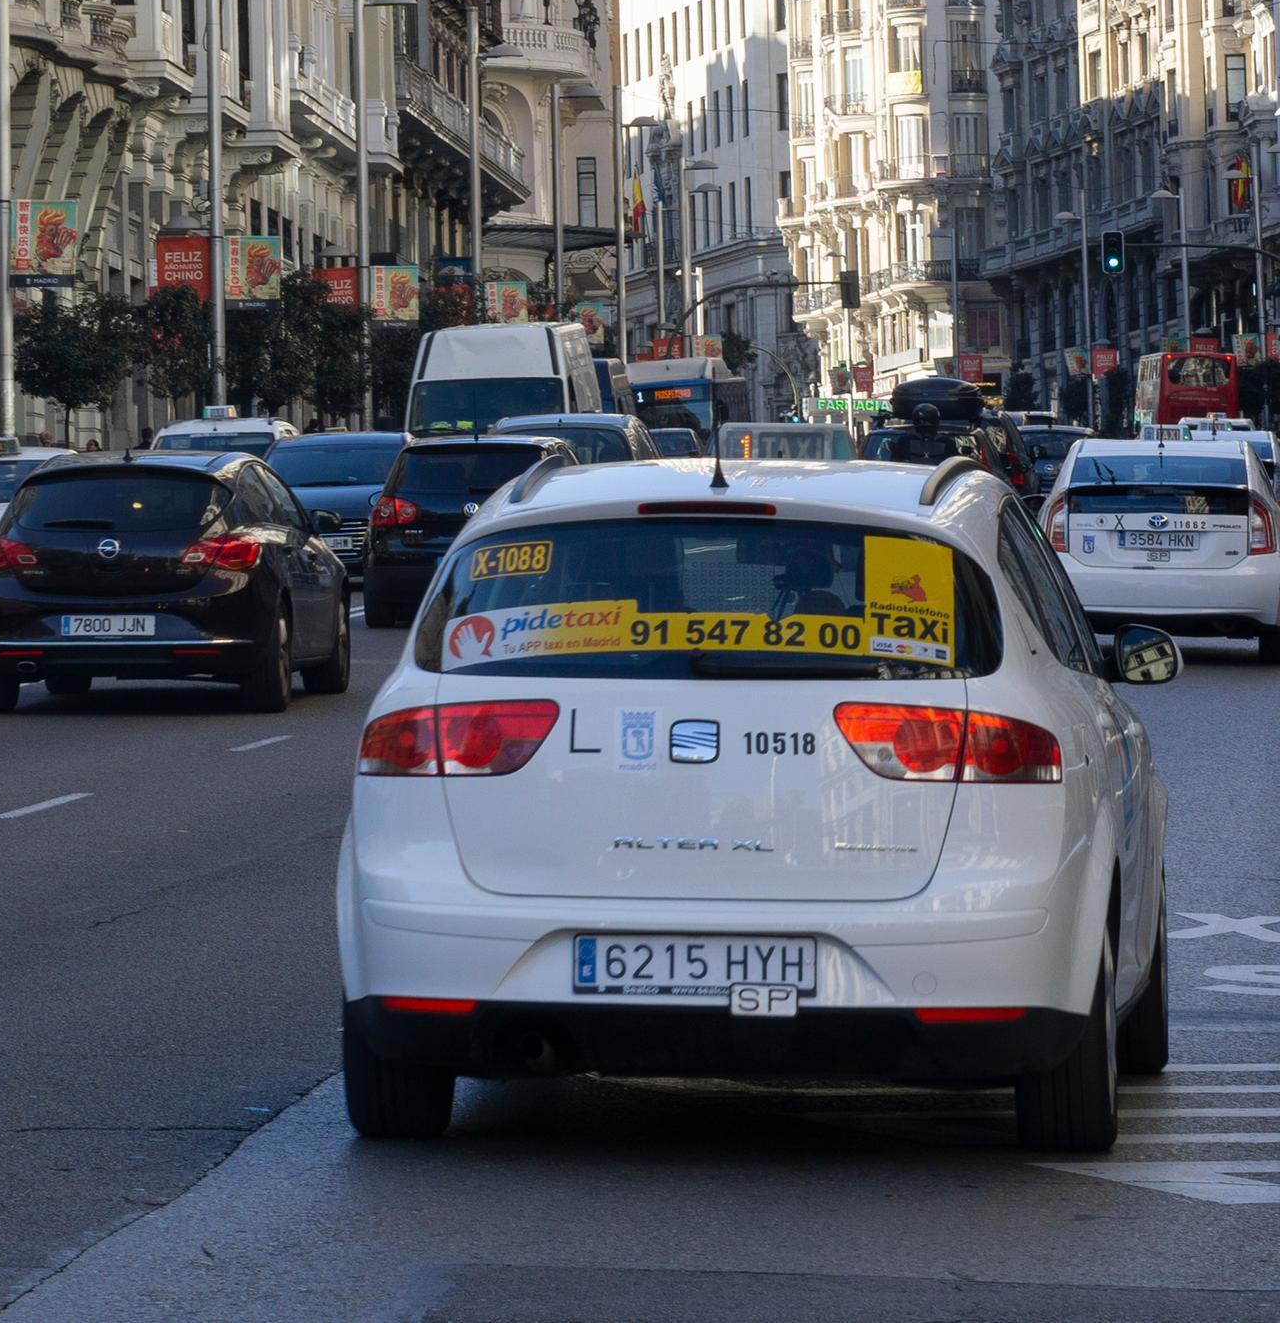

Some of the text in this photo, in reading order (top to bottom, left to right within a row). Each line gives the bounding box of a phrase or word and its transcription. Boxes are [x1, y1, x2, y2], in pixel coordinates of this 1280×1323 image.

[164, 251, 202, 262] FELIZ
[164, 271, 204, 281] CHINO
[327, 279, 352, 289] ELIZ
[637, 391, 644, 403] 1
[762, 436, 822, 459] TAXI
[1114, 514, 1124, 529] X
[1129, 533, 1195, 547] 3584 HKN
[474, 545, 546, 575] X-1088
[1148, 552, 1169, 560] SP
[870, 601, 950, 619] Radioteléfono
[74, 617, 146, 633] 7800 JJN
[500, 606, 623, 641] pidetaxi
[871, 612, 948, 644] Taxi
[630, 620, 861, 650] 91 547 82 00
[503, 636, 621, 654] Tu APP taxi en Madrid
[570, 708, 602, 753] L
[743, 731, 816, 755] 10518
[732, 839, 774, 852] XL
[604, 943, 804, 982] 6215 HYH
[738, 988, 790, 1013] SP
